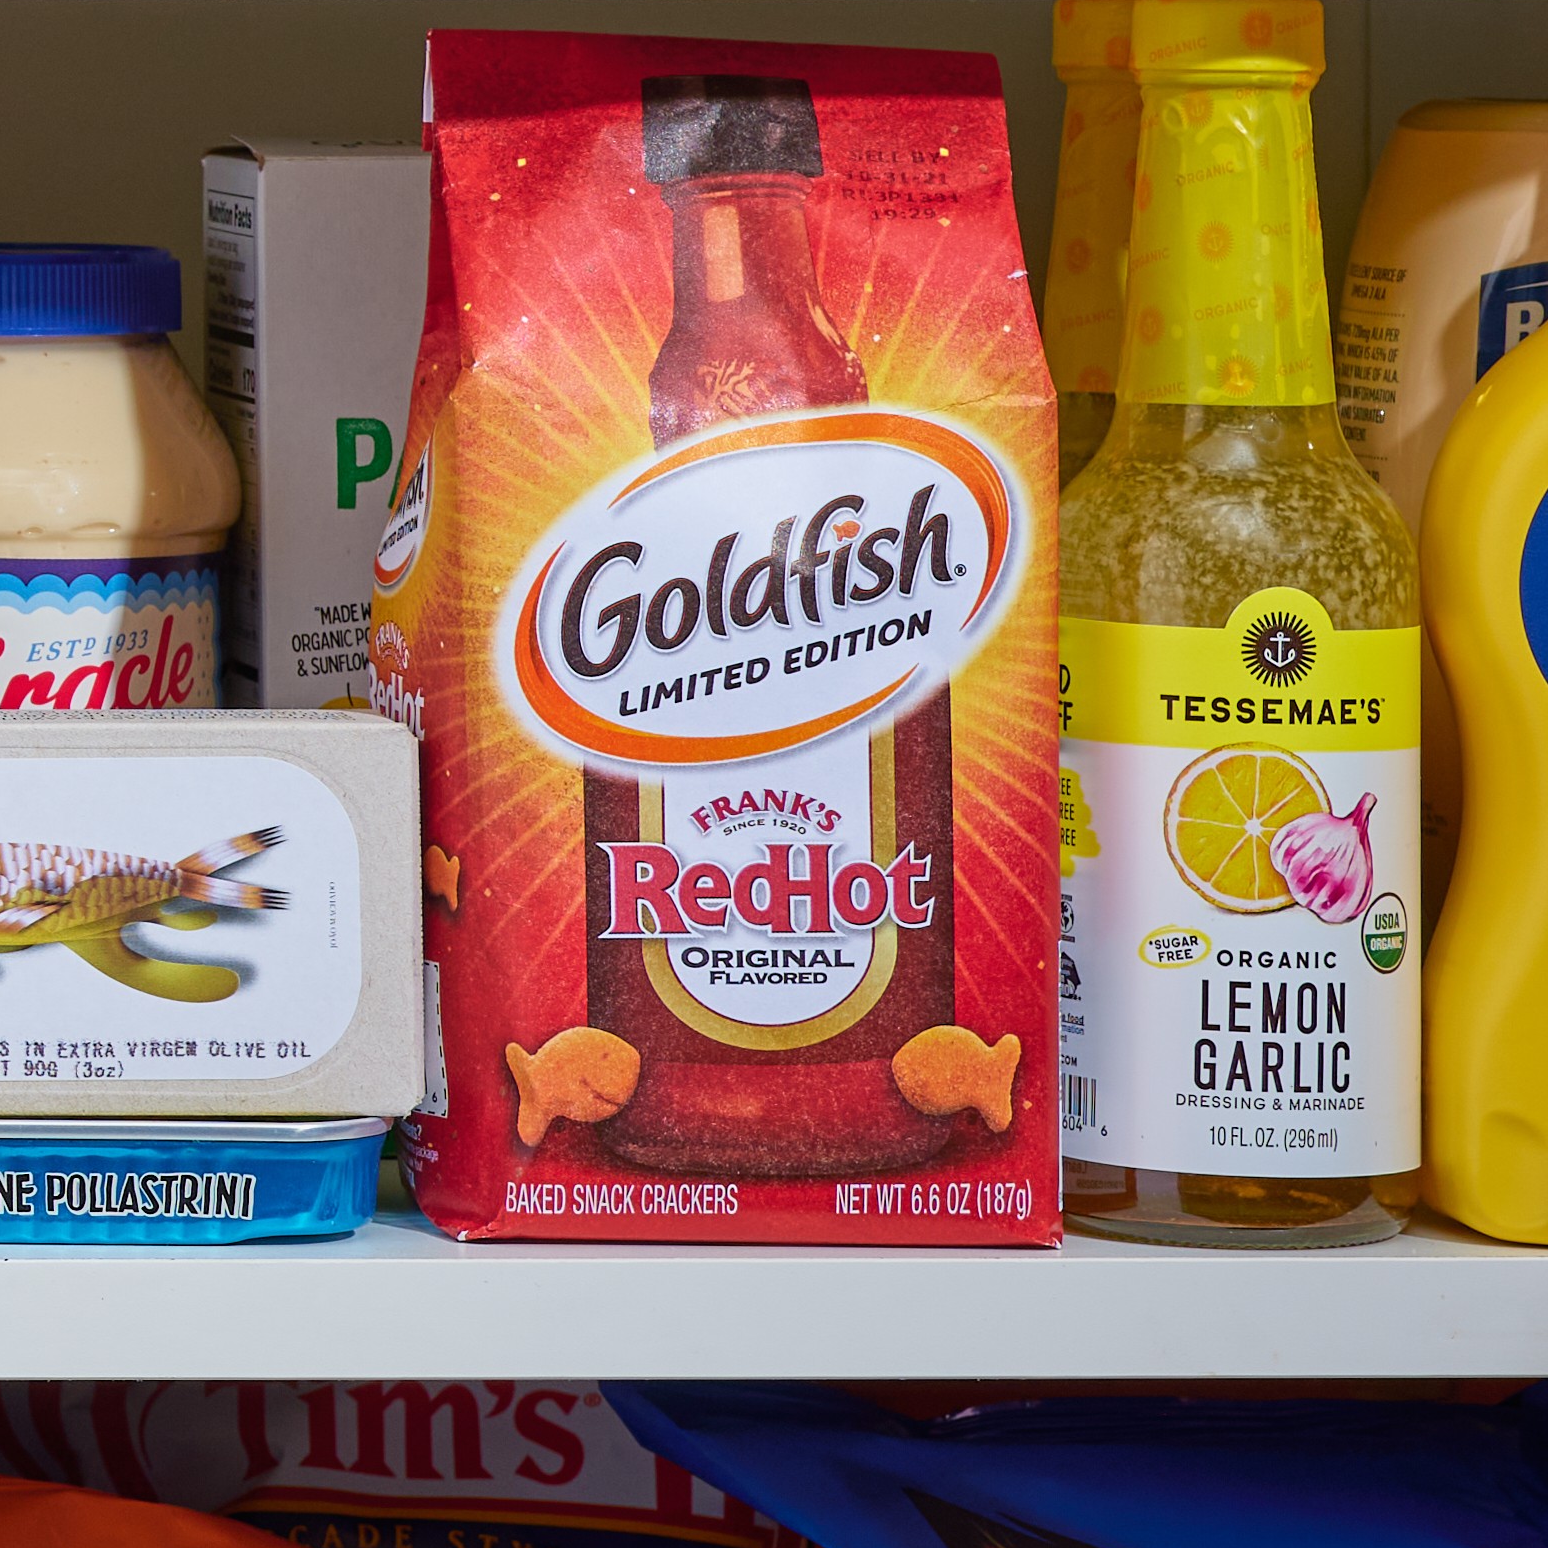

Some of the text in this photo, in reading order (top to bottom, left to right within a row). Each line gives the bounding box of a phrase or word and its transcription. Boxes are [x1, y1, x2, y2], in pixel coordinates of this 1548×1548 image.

[560, 484, 952, 678] Goldfish
[620, 610, 932, 717] LIMITED EDITION
[1160, 694, 1381, 726] TESSEMAE'S
[690, 788, 842, 835] FRANK'S
[598, 841, 935, 939] RedHot
[1375, 912, 1400, 931] USDA
[1201, 980, 1346, 1034] LEMON
[1193, 1041, 1351, 1093] GARLIC
[46, 1172, 255, 1220] POLLASTRINI
[505, 1182, 738, 1215] BAKED SNACK CRACKERS
[210, 1380, 585, 1484] Tim's
